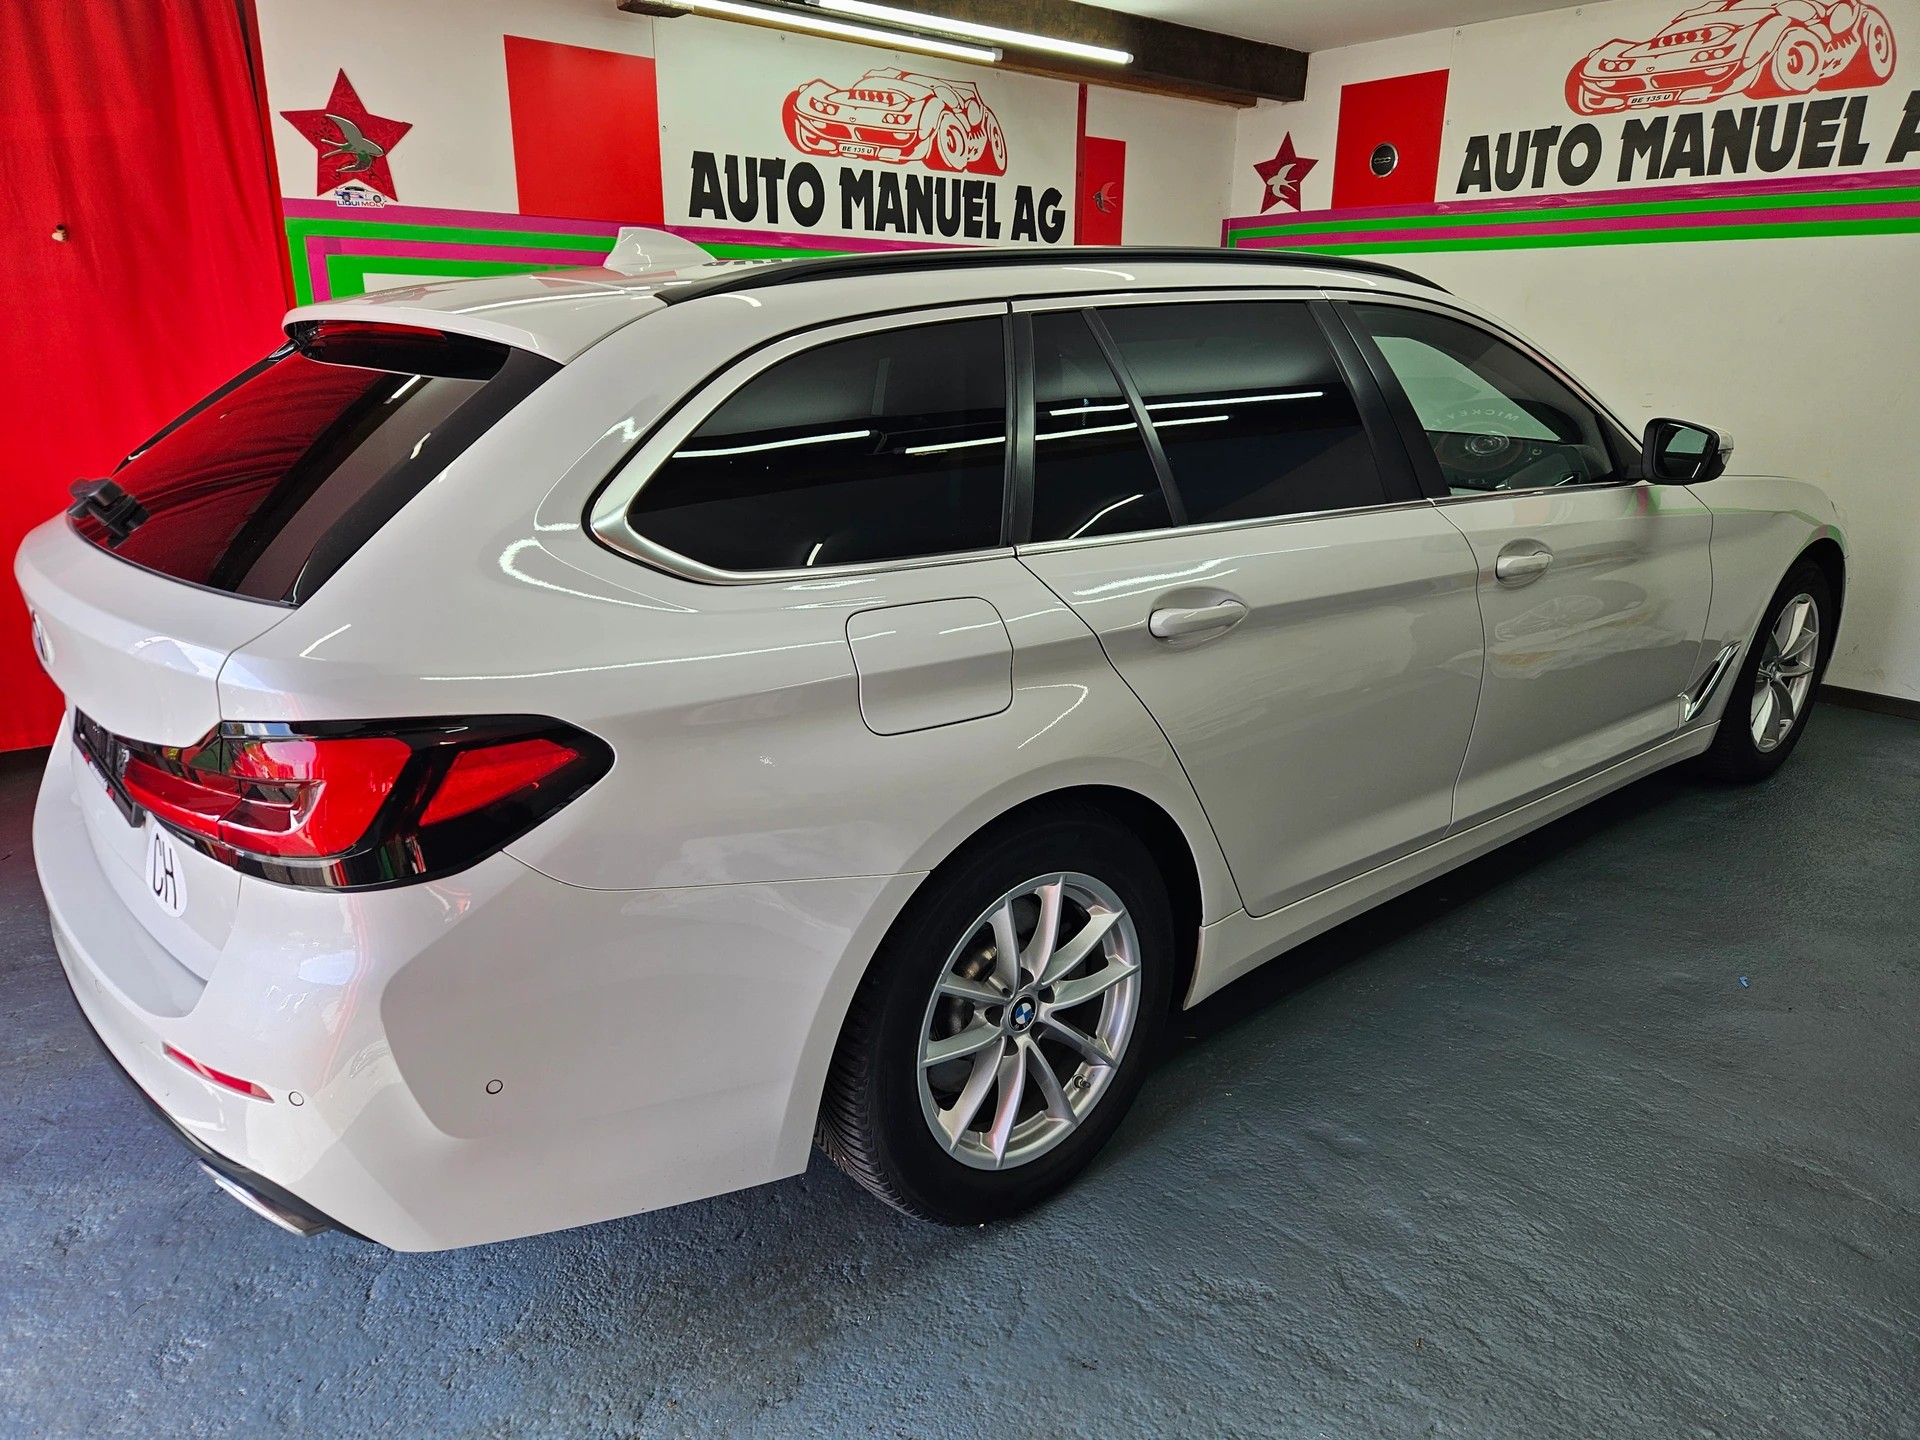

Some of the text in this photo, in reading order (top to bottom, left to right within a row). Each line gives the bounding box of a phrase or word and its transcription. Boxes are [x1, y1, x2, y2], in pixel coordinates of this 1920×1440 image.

[1456, 90, 1920, 194] AUTO MANUEL A
[689, 151, 1066, 244] AUTO MANUEL AG
[153, 833, 177, 910] CH
